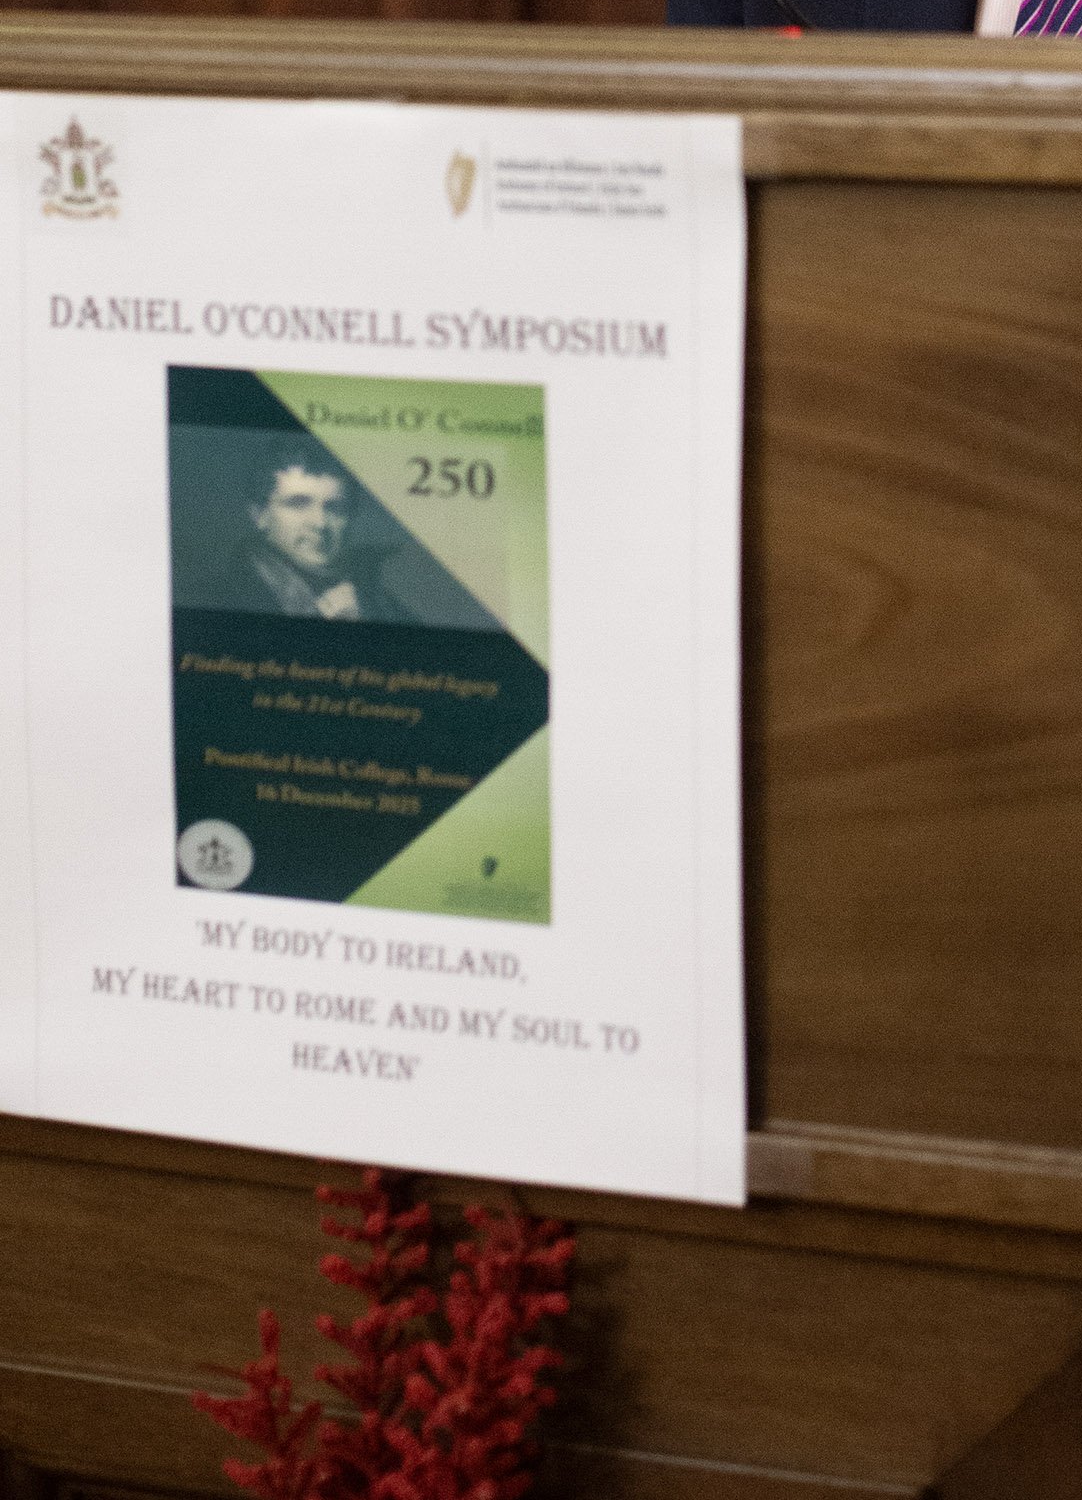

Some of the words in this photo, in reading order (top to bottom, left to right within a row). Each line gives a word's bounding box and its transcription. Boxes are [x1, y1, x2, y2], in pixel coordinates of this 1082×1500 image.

[49, 294, 194, 335] DANIEL
[202, 301, 416, 346] O'CONNELL
[425, 306, 668, 359] SYMPOSIUM
[306, 402, 392, 431] Daniel
[406, 455, 496, 499] 250
[346, 697, 422, 725] Century
[252, 926, 335, 960] BODY
[339, 933, 377, 965] TO
[386, 939, 528, 985] IRELAND,
[93, 967, 137, 996] MY
[142, 972, 240, 1009] HEART
[249, 982, 287, 1014] TO
[295, 990, 378, 1025] ROME
[387, 1002, 450, 1034] AND
[458, 1007, 507, 1040] MY
[511, 1014, 592, 1051] SOUL
[600, 1021, 642, 1055] TO
